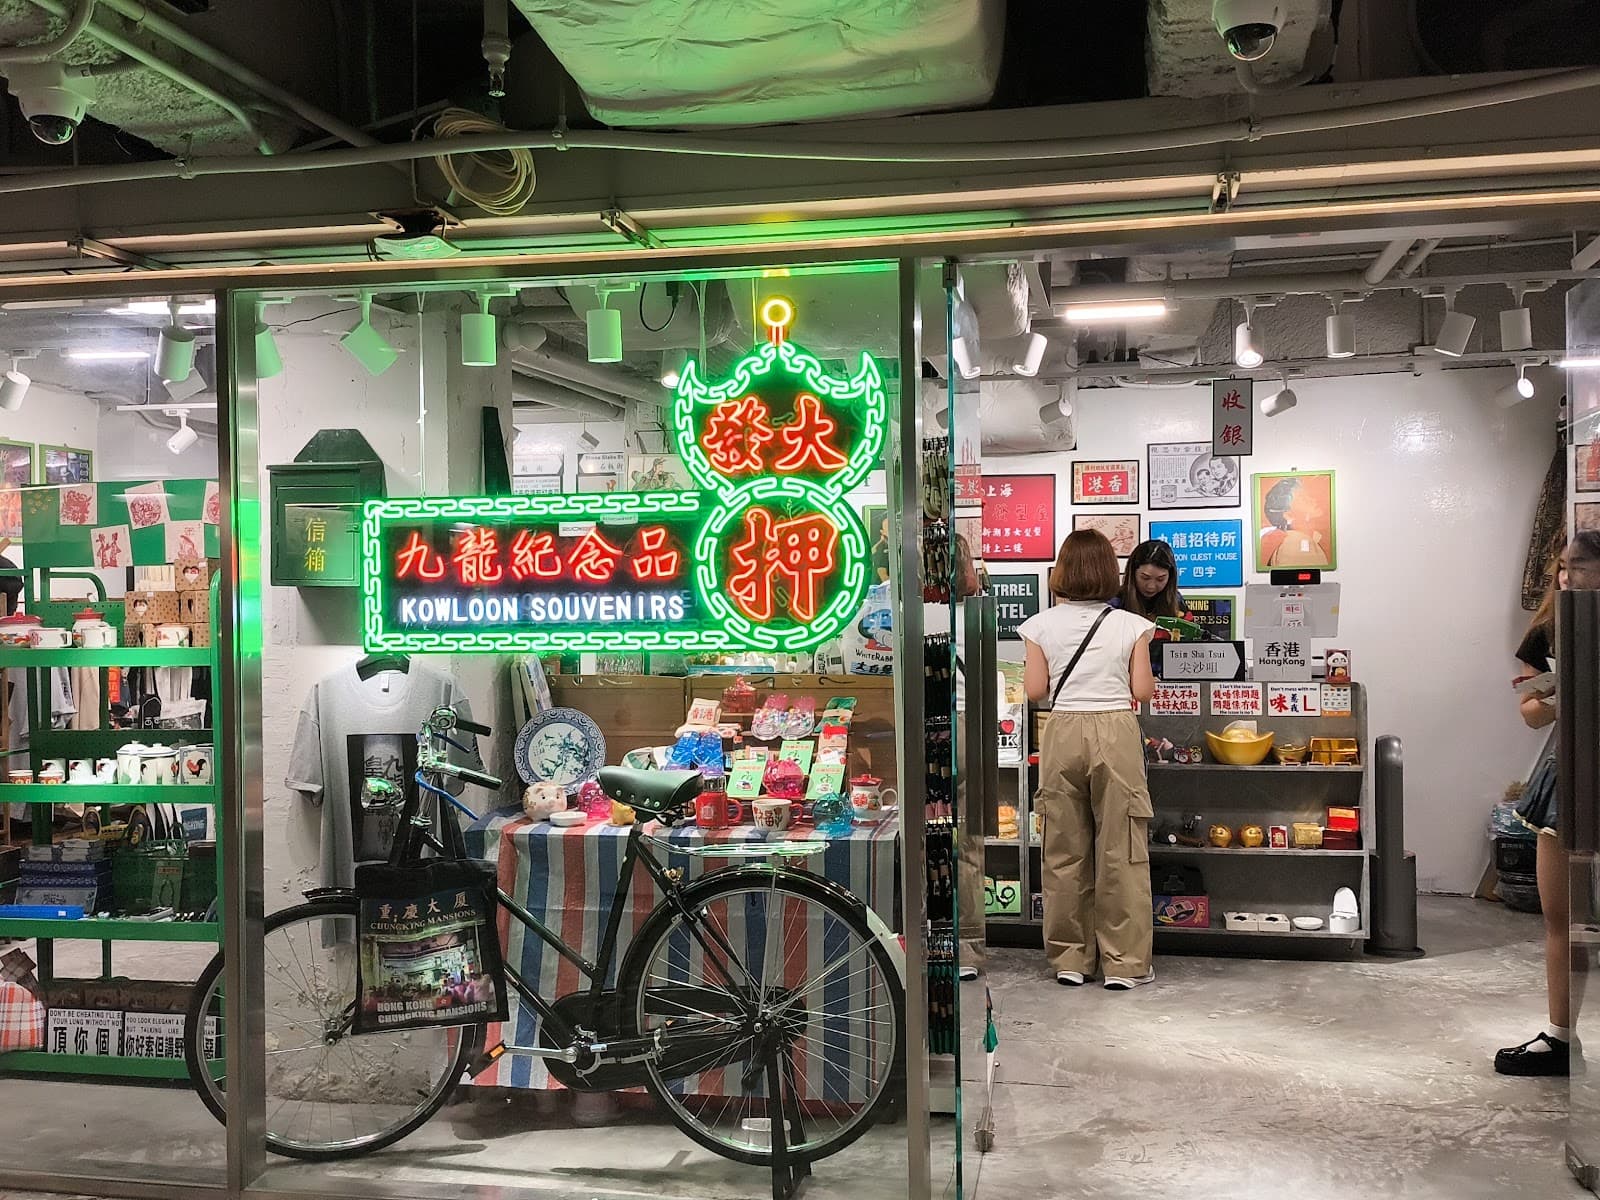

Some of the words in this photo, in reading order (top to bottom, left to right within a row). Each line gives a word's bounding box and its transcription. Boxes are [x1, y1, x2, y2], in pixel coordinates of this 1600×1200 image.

[1220, 388, 1247, 445] 收銀
[304, 517, 327, 573] 信箱
[396, 526, 679, 584] 九龍紀念品
[1190, 553, 1212, 562] GUEST
[1215, 552, 1238, 561] HOUSE
[727, 506, 838, 621] 押
[993, 584, 1034, 597] TRREL
[401, 596, 518, 622] KOWLOON
[530, 594, 685, 621] SOUVENIRS
[1170, 650, 1188, 659] Tsim
[1191, 650, 1205, 659] Sha
[1209, 650, 1225, 659] Tsui
[1265, 641, 1300, 658] 香港
[1259, 657, 1305, 667] HongKong
[1152, 690, 1198, 700] 若要人不知
[1304, 695, 1316, 711] L
[427, 910, 476, 924] MANSIONS
[376, 1000, 404, 1013] HONG
[405, 999, 433, 1011] KONG
[436, 1001, 488, 1017] MANSIONS
